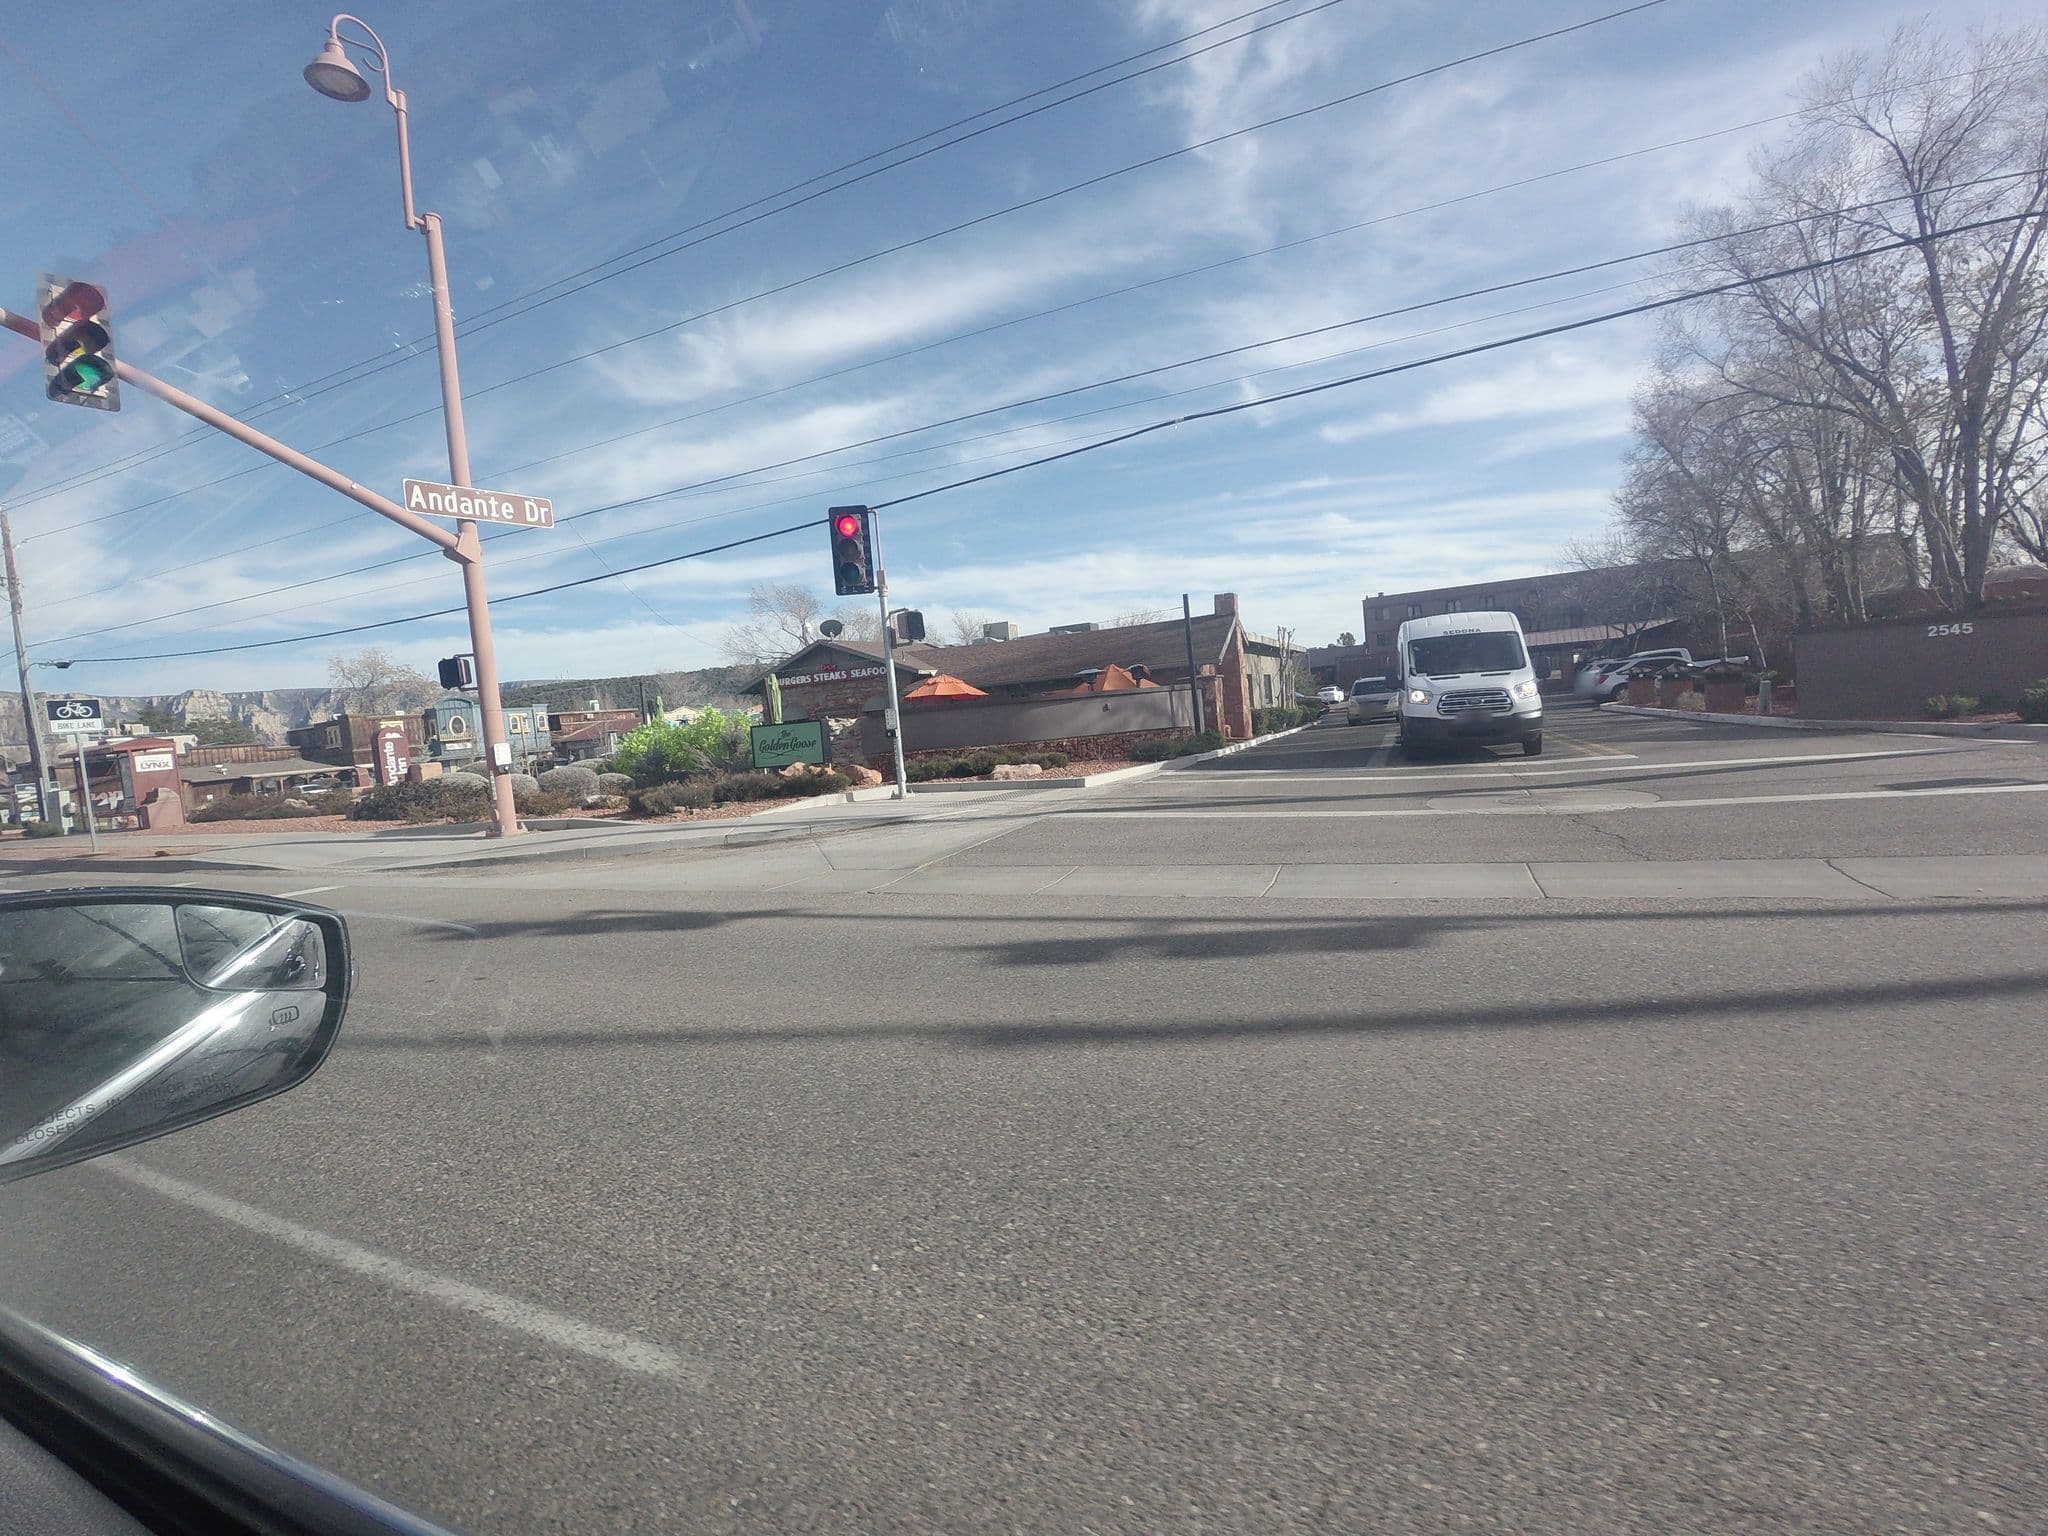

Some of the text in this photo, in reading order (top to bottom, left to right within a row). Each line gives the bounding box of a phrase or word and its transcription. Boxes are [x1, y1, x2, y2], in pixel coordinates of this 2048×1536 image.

[410, 485, 549, 523] Andante Dr
[1927, 622, 1974, 637] 2545
[779, 674, 812, 686] URGERS
[813, 670, 847, 682] STEAKS
[850, 666, 887, 678] SEAFOO
[78, 721, 96, 729] LANE
[759, 738, 789, 753] Golden
[397, 757, 408, 774] Inn
